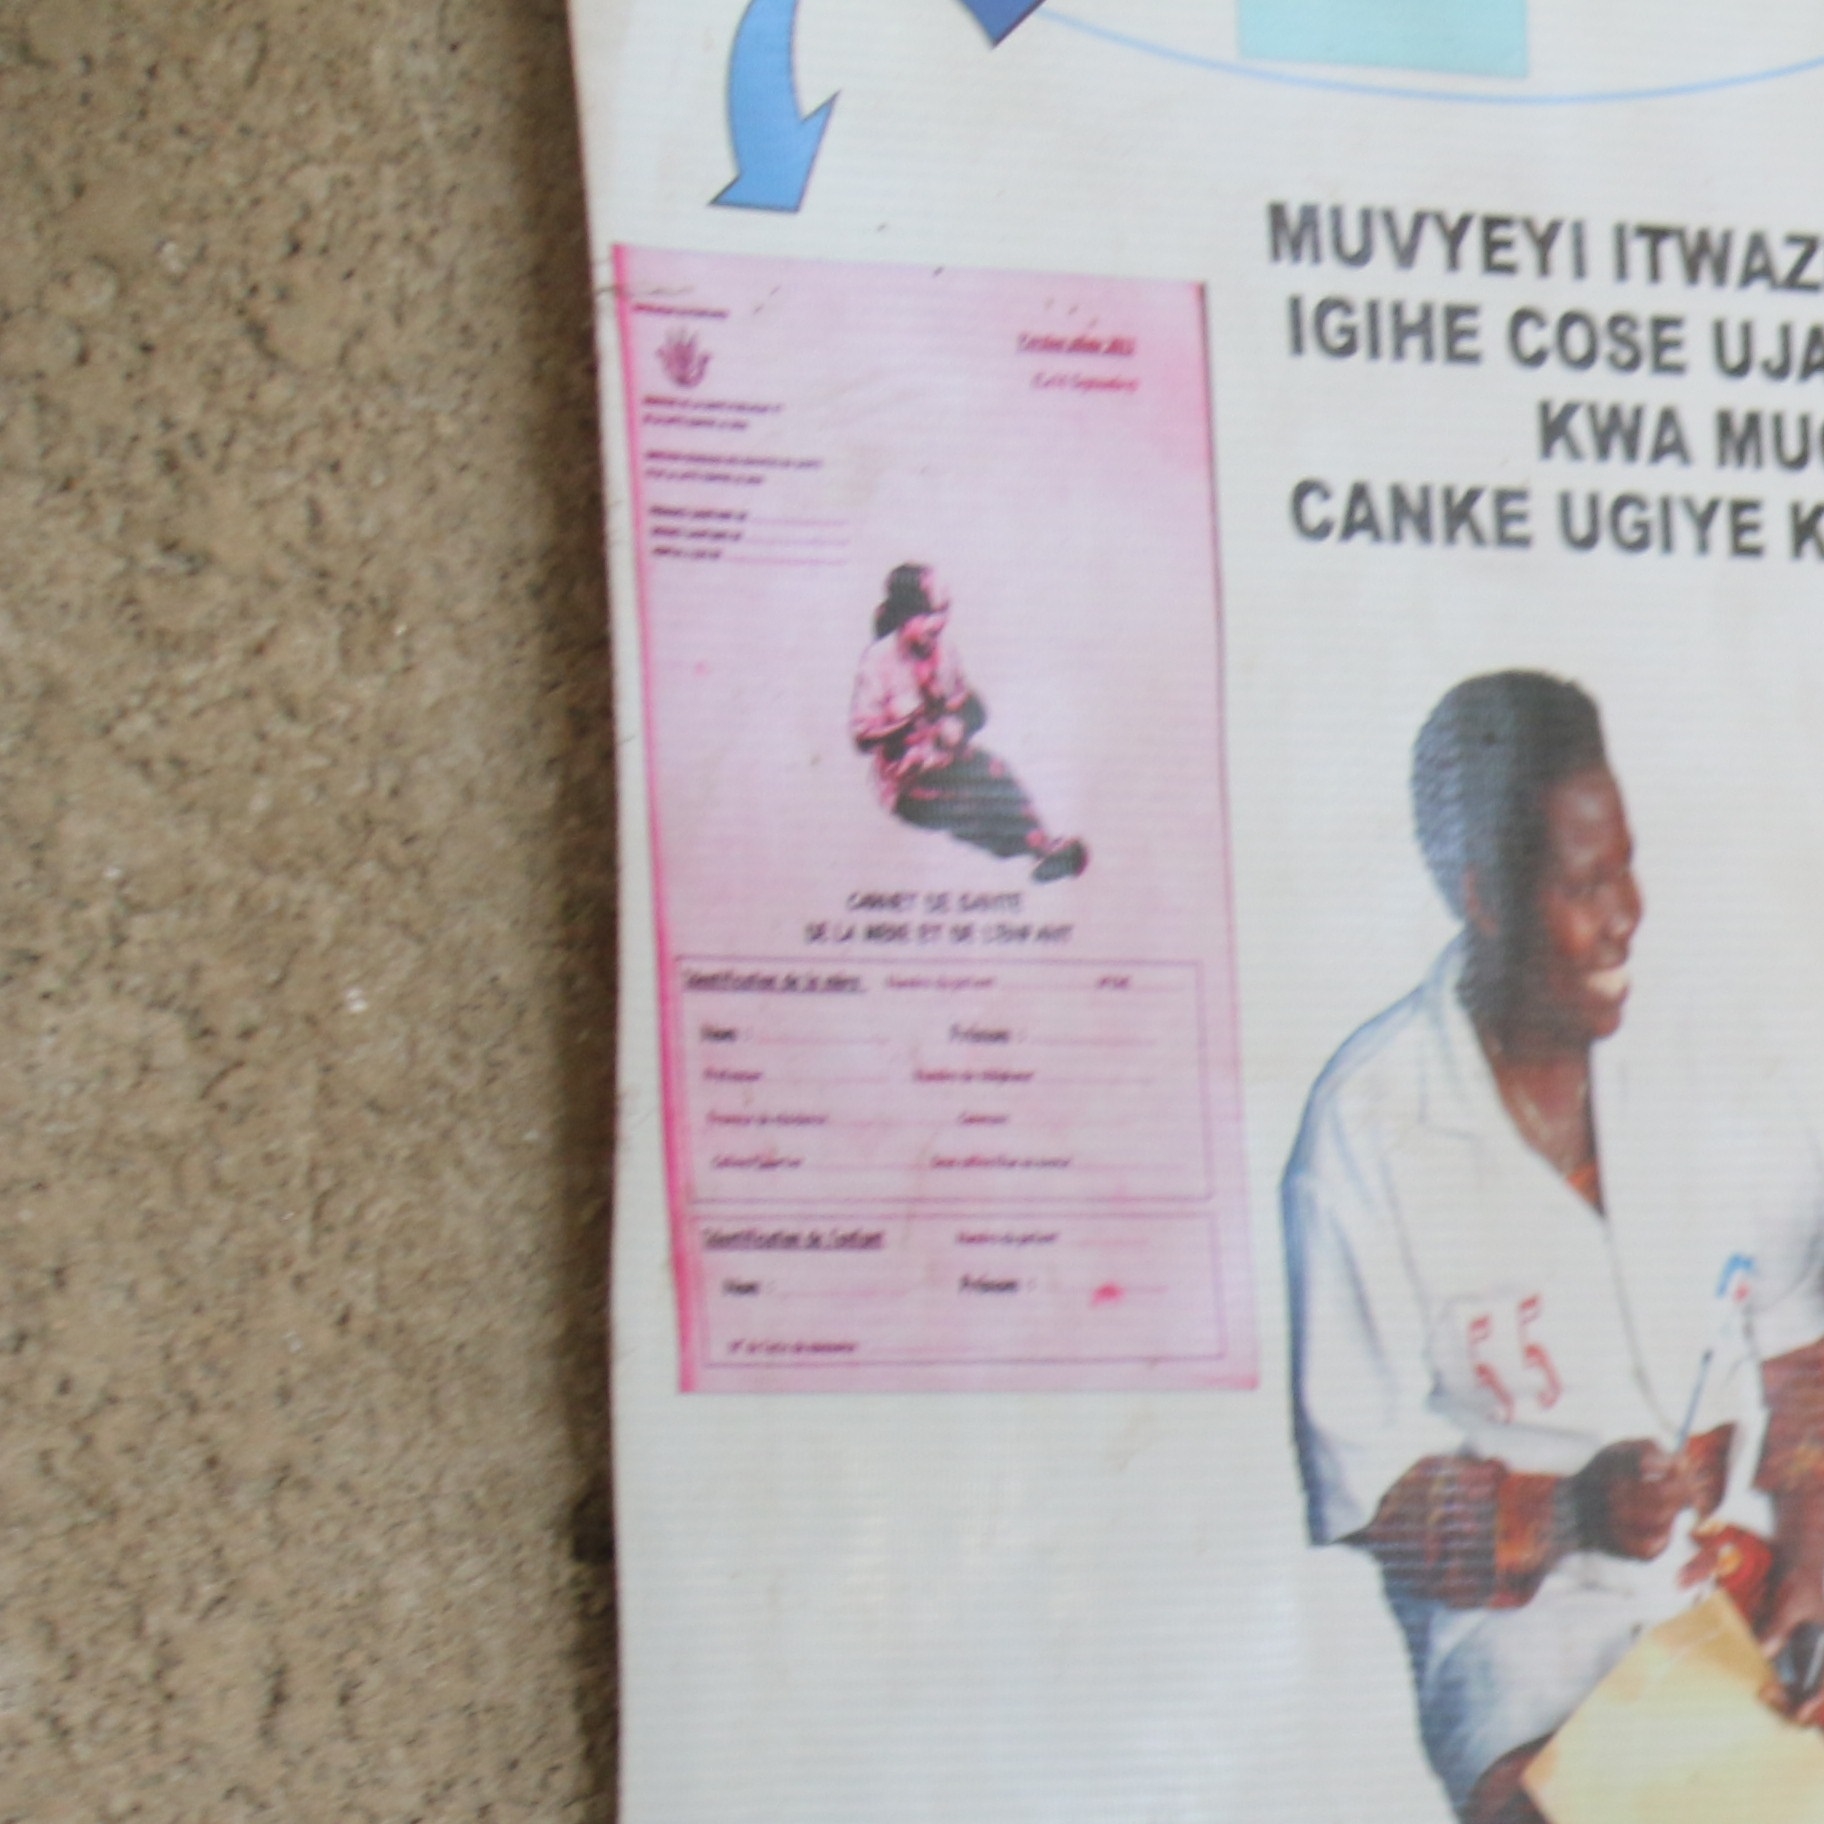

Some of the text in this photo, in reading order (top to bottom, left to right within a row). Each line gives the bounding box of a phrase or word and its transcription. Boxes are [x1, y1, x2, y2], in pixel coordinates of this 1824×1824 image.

[1265, 199, 1589, 282] MUVYEYI
[1286, 293, 1483, 367] IGIHE
[1505, 304, 1687, 377] COSE
[1536, 398, 1693, 467] KWA
[1288, 477, 1534, 551] CANKE
[1556, 489, 1767, 561] UGIYE
